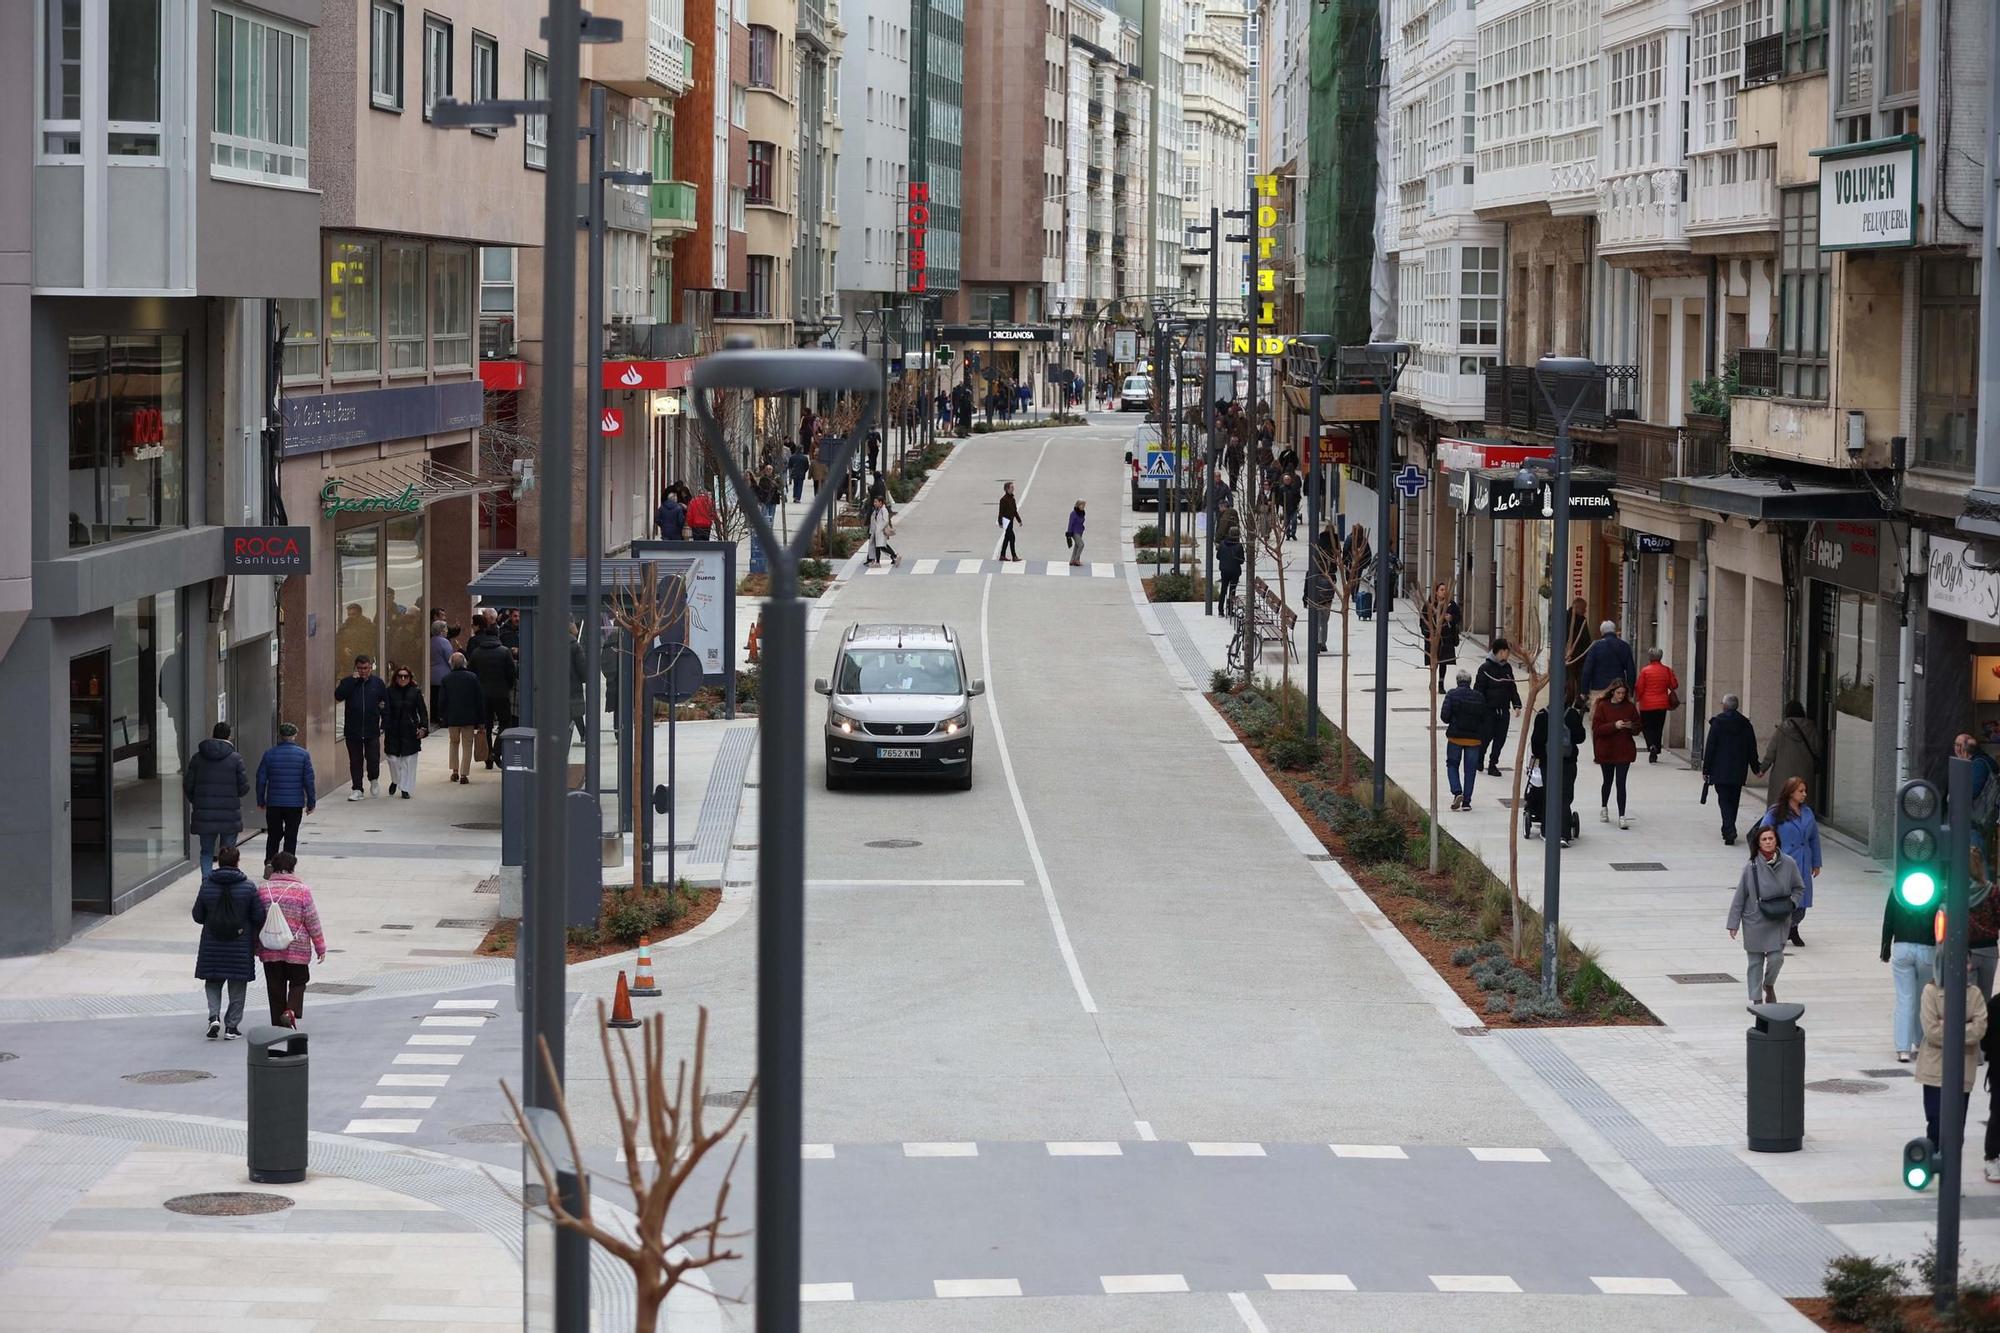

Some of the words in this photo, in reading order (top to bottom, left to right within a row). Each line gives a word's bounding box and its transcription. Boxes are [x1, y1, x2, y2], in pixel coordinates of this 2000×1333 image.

[1835, 164, 1895, 204] VOLUMEN
[1862, 209, 1908, 236] PELUQUERIA
[134, 408, 164, 442] ROCA
[321, 480, 421, 520] Garrote
[1494, 495, 1508, 512] La
[1568, 495, 1611, 507] NFITERÍA
[235, 537, 299, 555] ROCA
[882, 749, 903, 758] 7652
